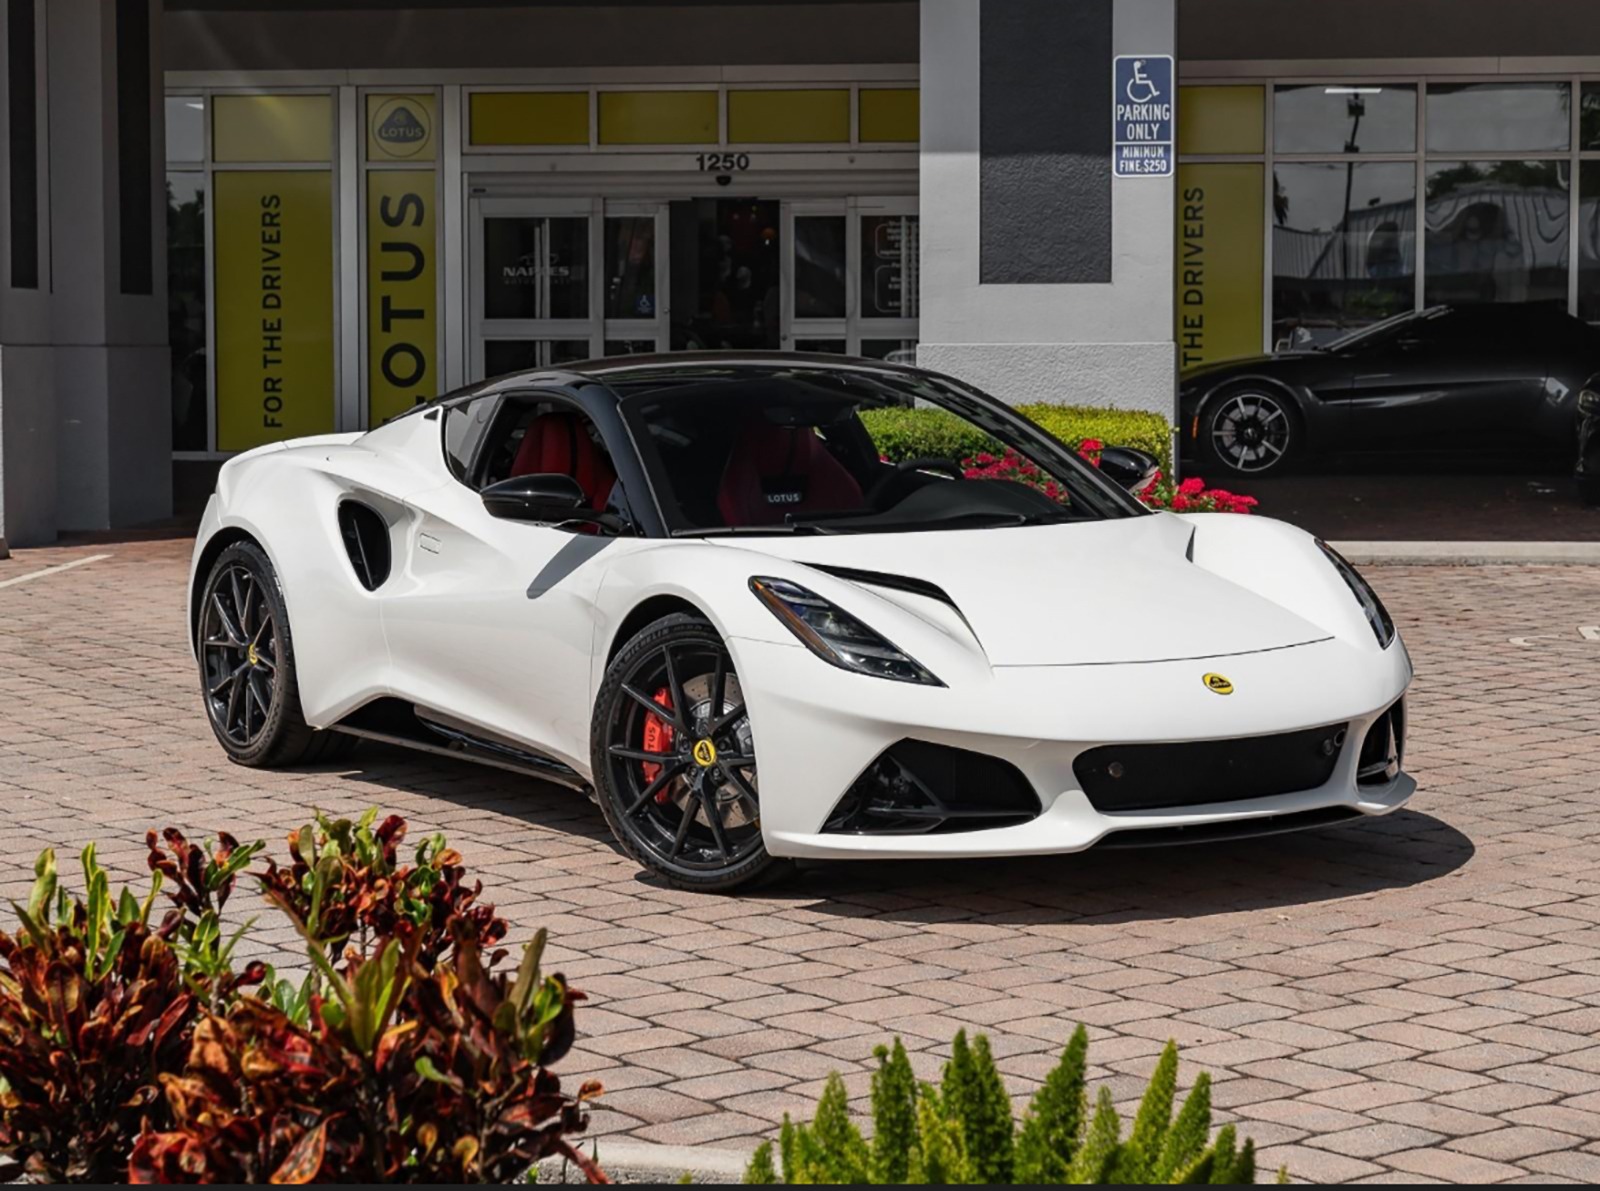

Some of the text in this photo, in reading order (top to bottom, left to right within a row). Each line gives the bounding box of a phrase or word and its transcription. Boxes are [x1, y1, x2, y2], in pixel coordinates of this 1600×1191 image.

[1116, 104, 1170, 121] PARKING
[382, 127, 422, 137] LOTUS
[1126, 123, 1160, 140] ONLY
[1122, 146, 1165, 158] MINIMUM
[696, 153, 750, 171] 1250
[1119, 159, 1167, 173] FINE $250
[503, 266, 570, 277] NAPES
[1183, 187, 1204, 367] THE DRIVERS
[261, 194, 283, 428] FOR THE DRIVERS
[380, 193, 426, 422] OTUS
[767, 493, 800, 503] LOTUS
